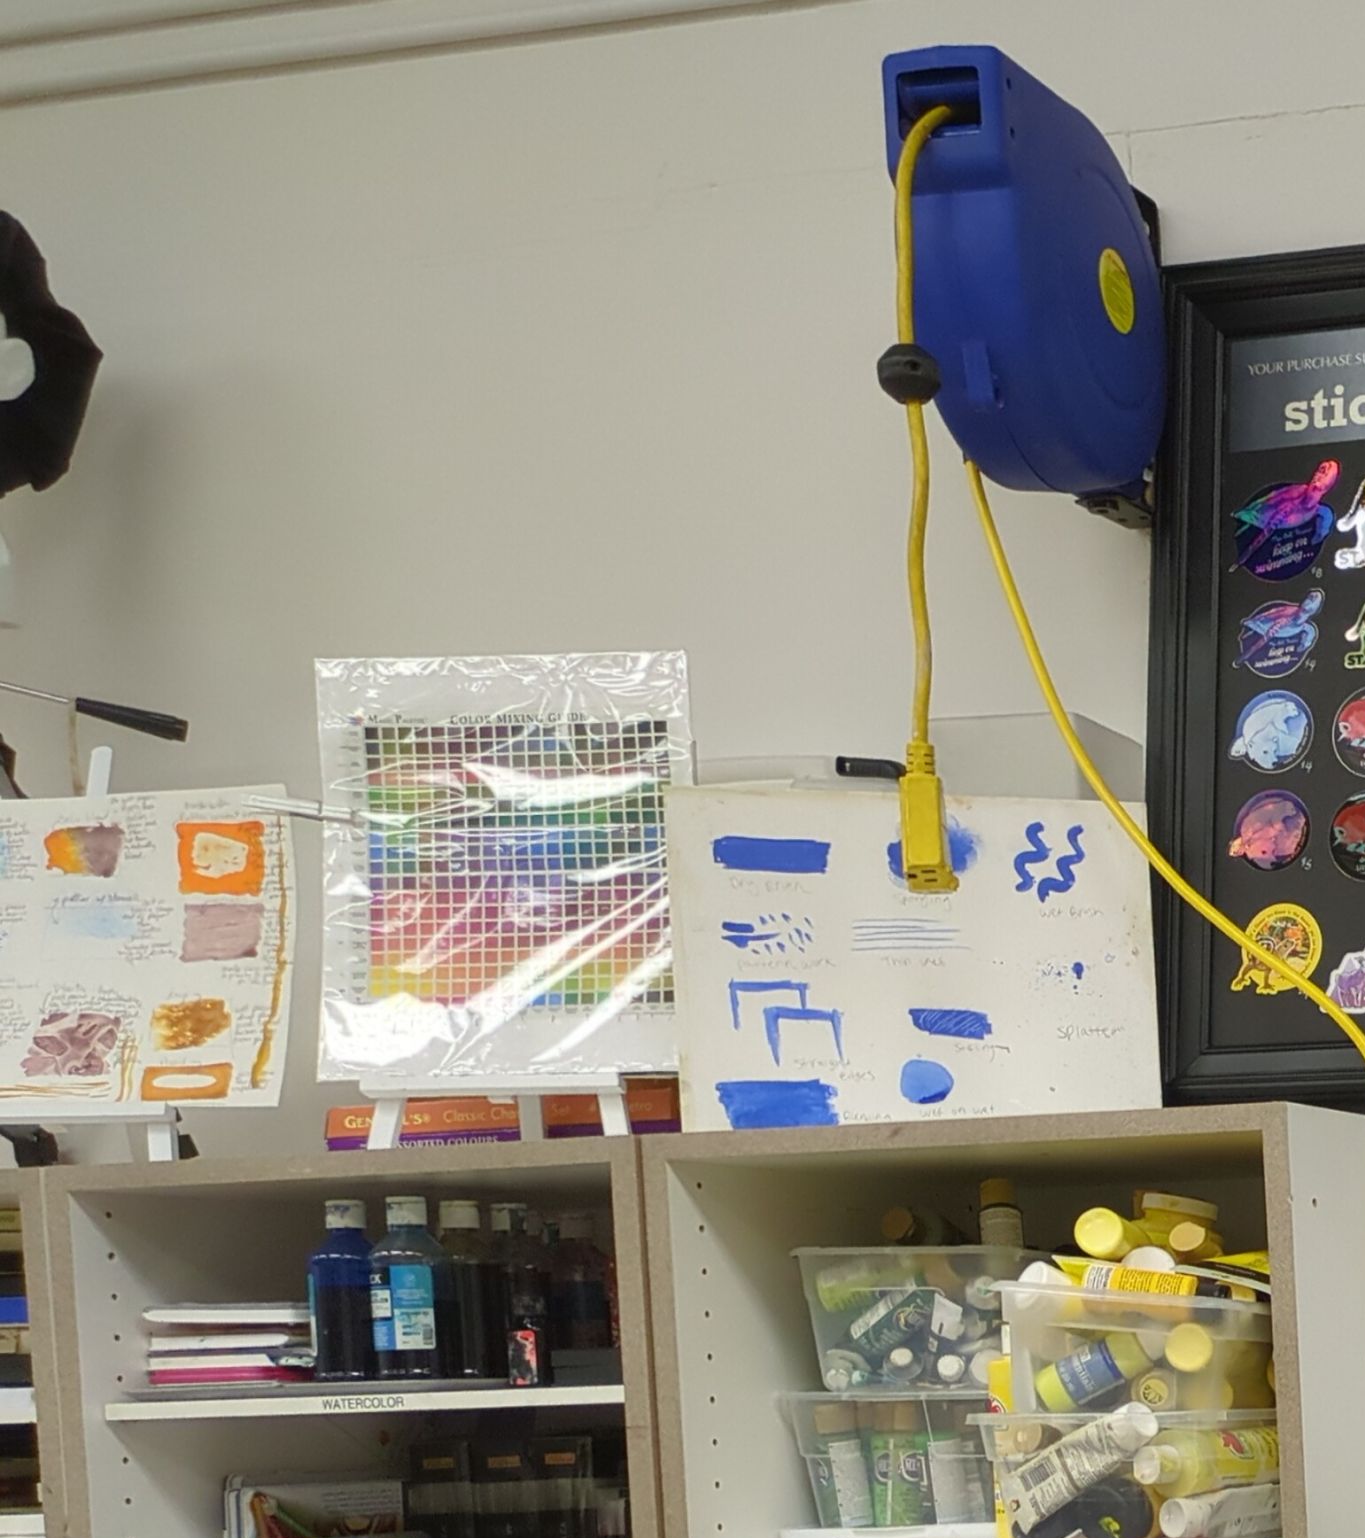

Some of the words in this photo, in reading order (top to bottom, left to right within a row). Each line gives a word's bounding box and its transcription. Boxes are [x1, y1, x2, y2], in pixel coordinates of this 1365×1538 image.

[1248, 364, 1284, 376] YOUR
[1287, 354, 1352, 372] PURCHASE
[495, 712, 543, 724] MIXING
[396, 1136, 447, 1149] SSORTED
[322, 1396, 405, 1411] WATERCOLOR
